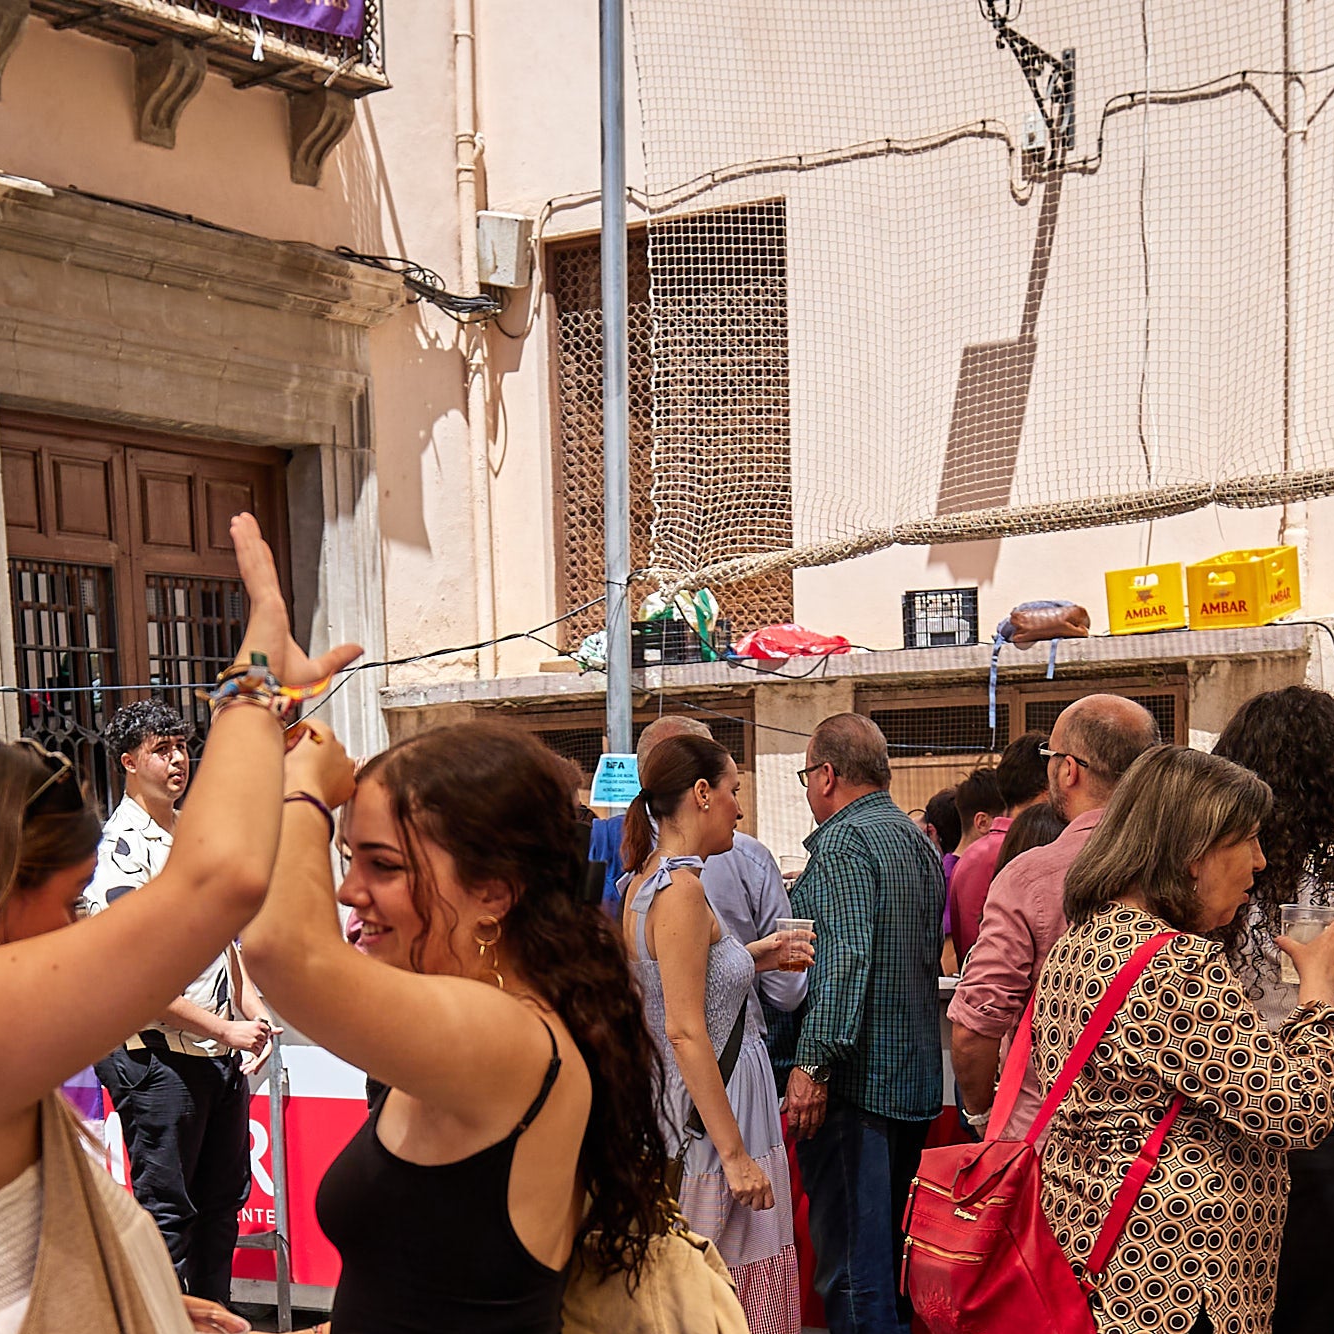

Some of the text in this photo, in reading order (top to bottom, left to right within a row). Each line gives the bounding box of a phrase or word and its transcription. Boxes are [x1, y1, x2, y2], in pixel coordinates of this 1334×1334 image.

[1270, 587, 1292, 604] AMBAR
[1125, 605, 1167, 620] AMBAR
[1201, 600, 1248, 615] AMBAR
